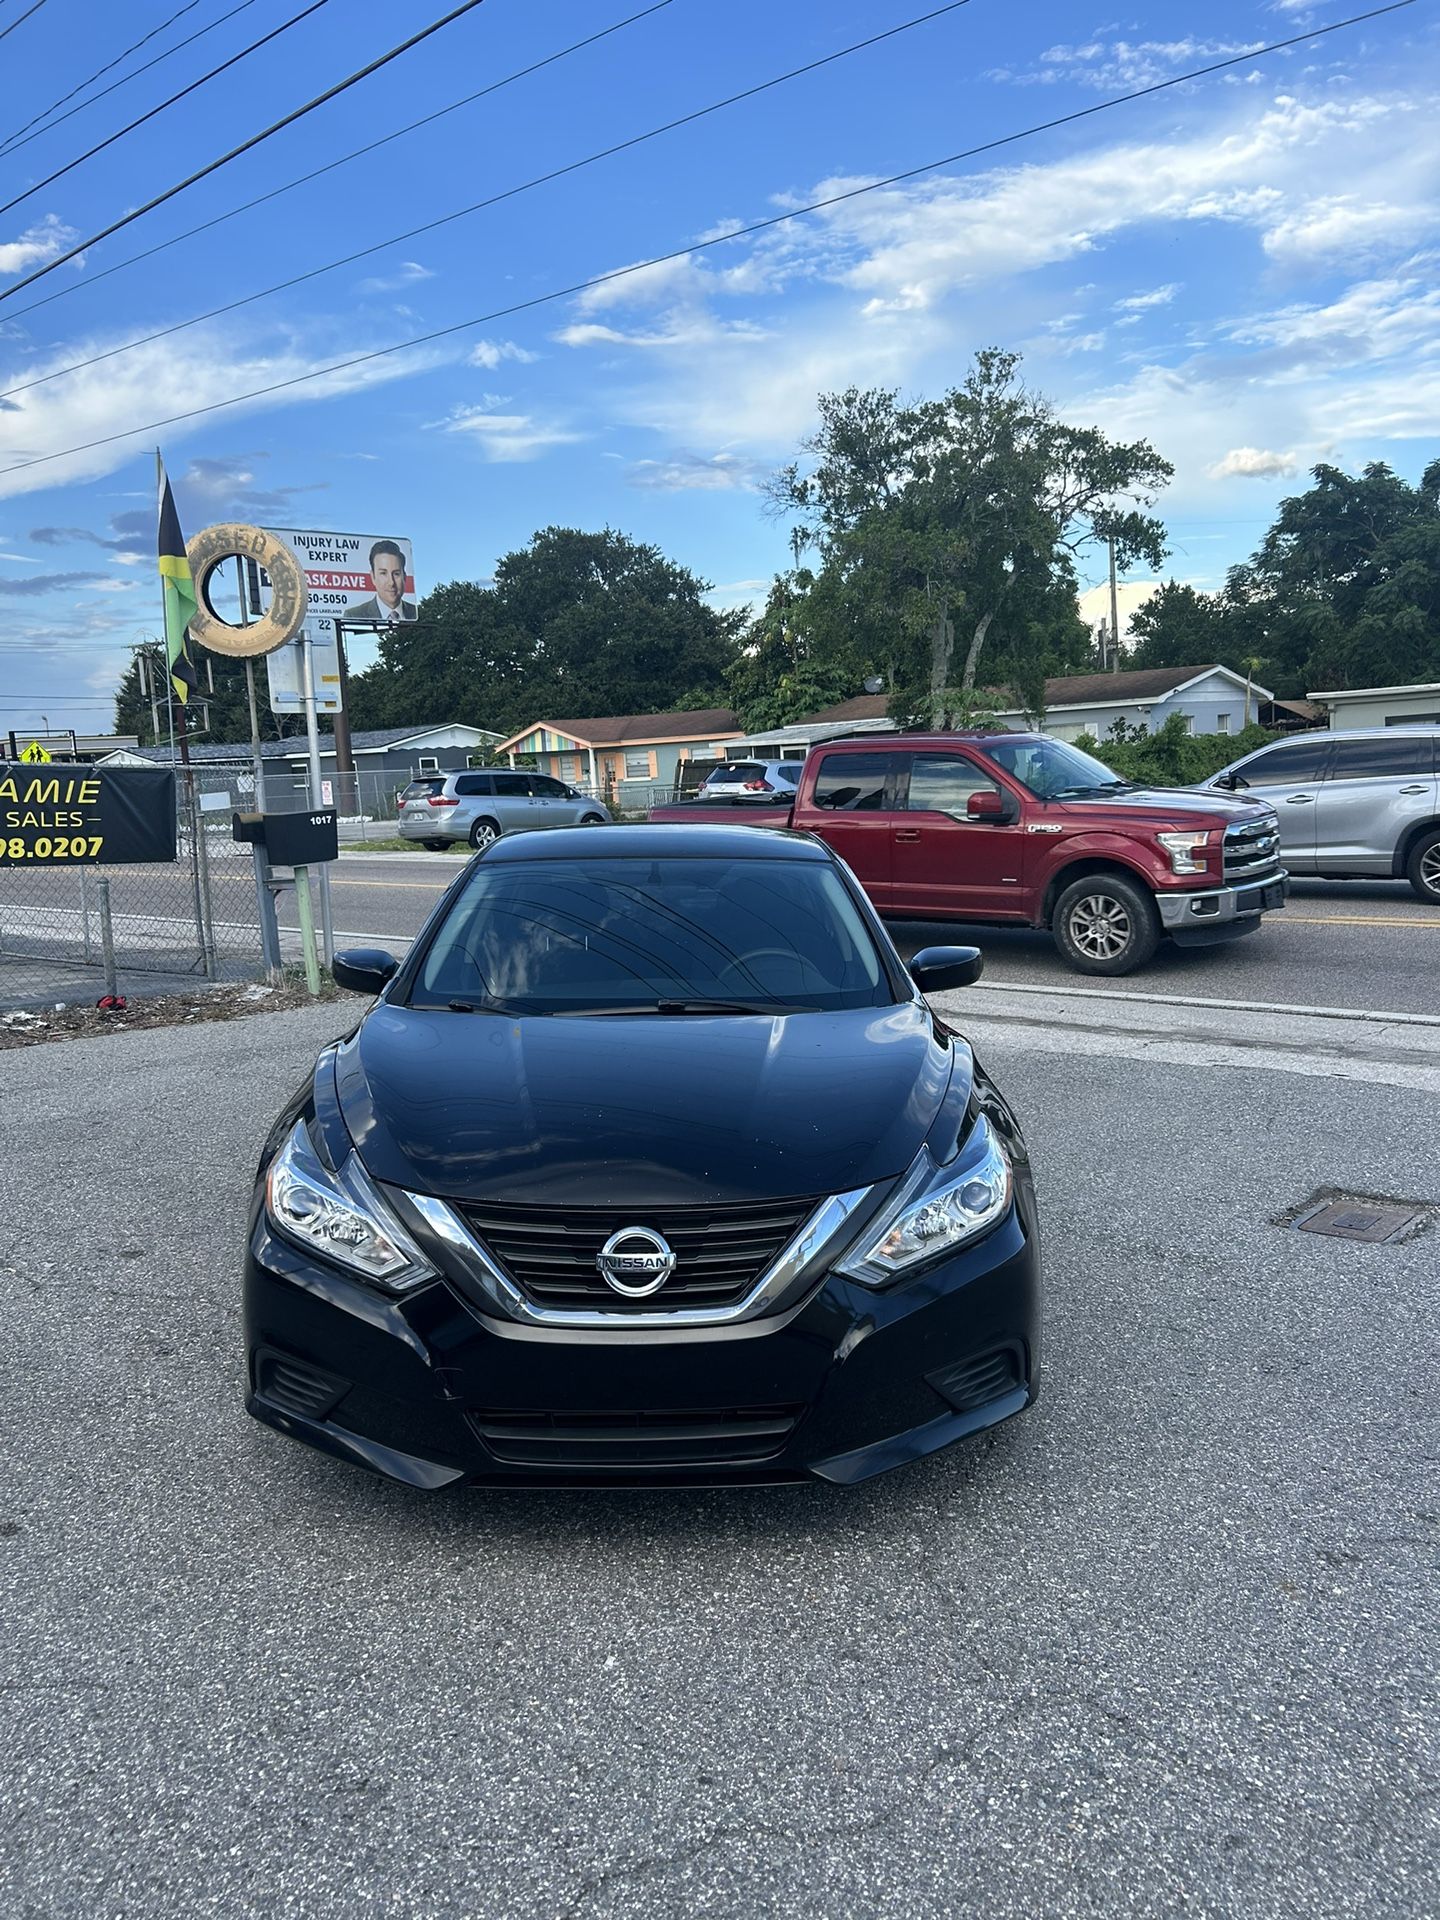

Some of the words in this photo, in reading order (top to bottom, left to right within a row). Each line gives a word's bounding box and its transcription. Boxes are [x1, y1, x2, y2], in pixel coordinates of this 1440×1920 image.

[294, 535, 332, 549] INJURY
[336, 539, 360, 550] LAW
[309, 551, 348, 562] EXPERT
[318, 619, 331, 630] 22
[6, 811, 83, 827] SALES
[310, 816, 332, 826] 1017
[605, 1257, 668, 1269] NISSAN
